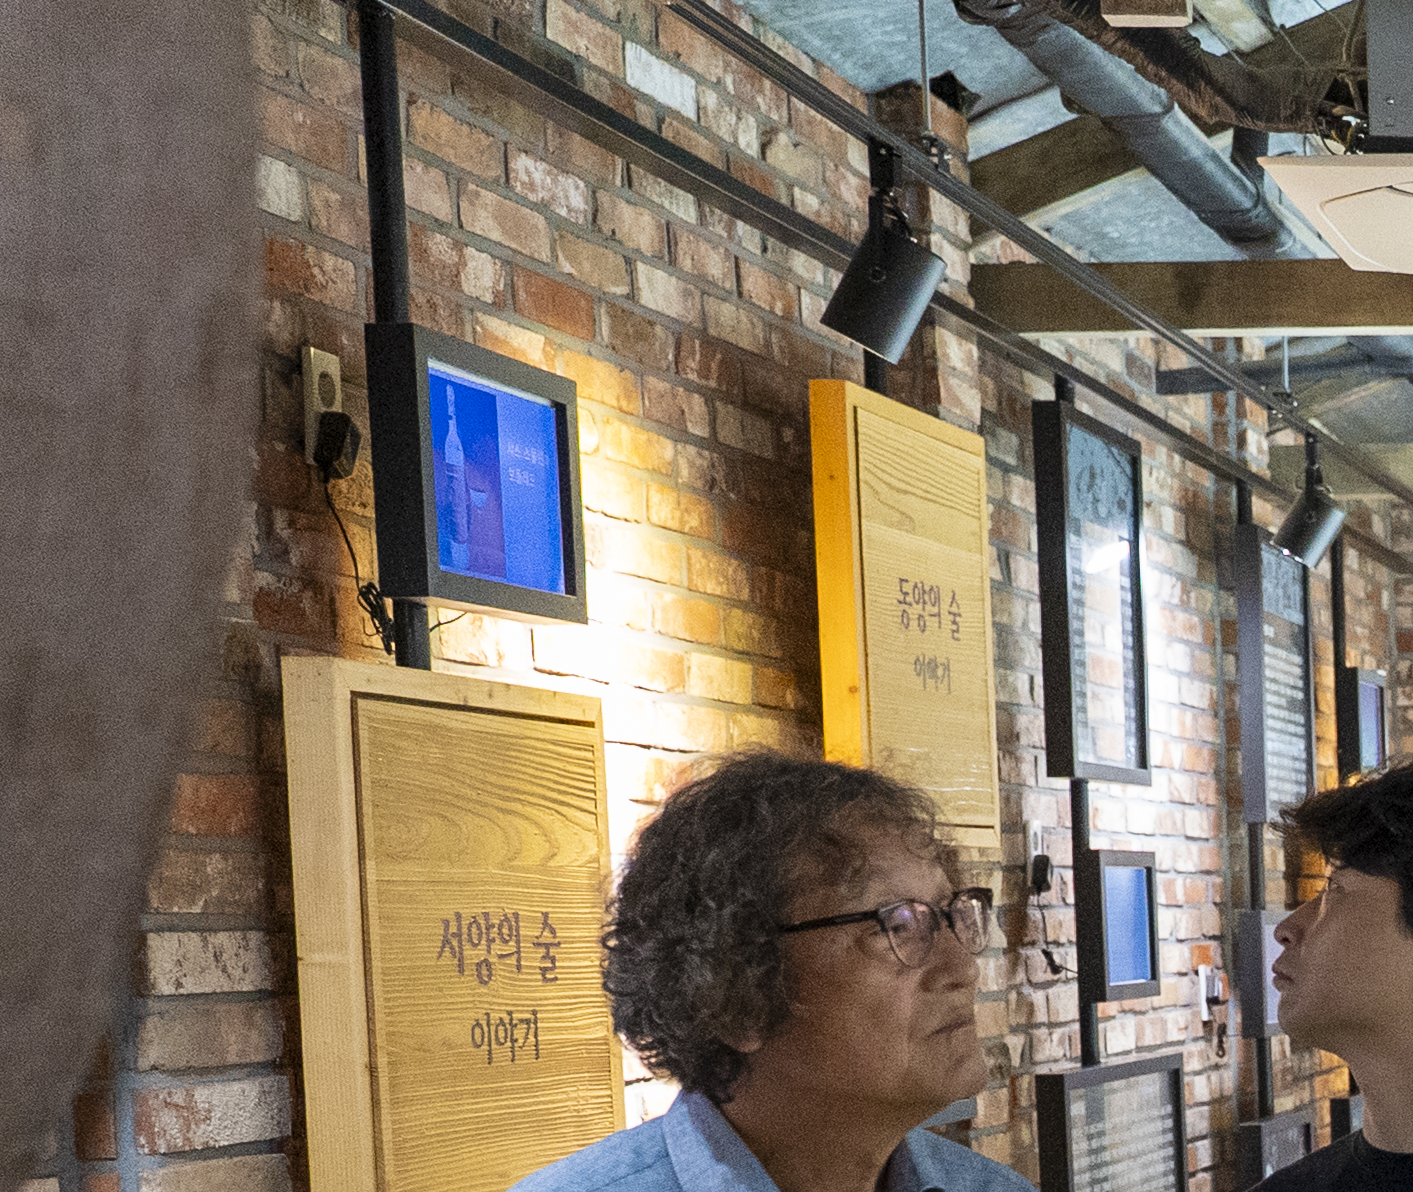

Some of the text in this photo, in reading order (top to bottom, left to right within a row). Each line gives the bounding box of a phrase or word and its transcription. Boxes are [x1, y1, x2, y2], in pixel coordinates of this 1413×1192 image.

[897, 577, 962, 642] 동양의 술
[913, 653, 951, 694] 이야기
[437, 910, 562, 986] 서양의 술
[471, 1009, 541, 1065] 이야기
